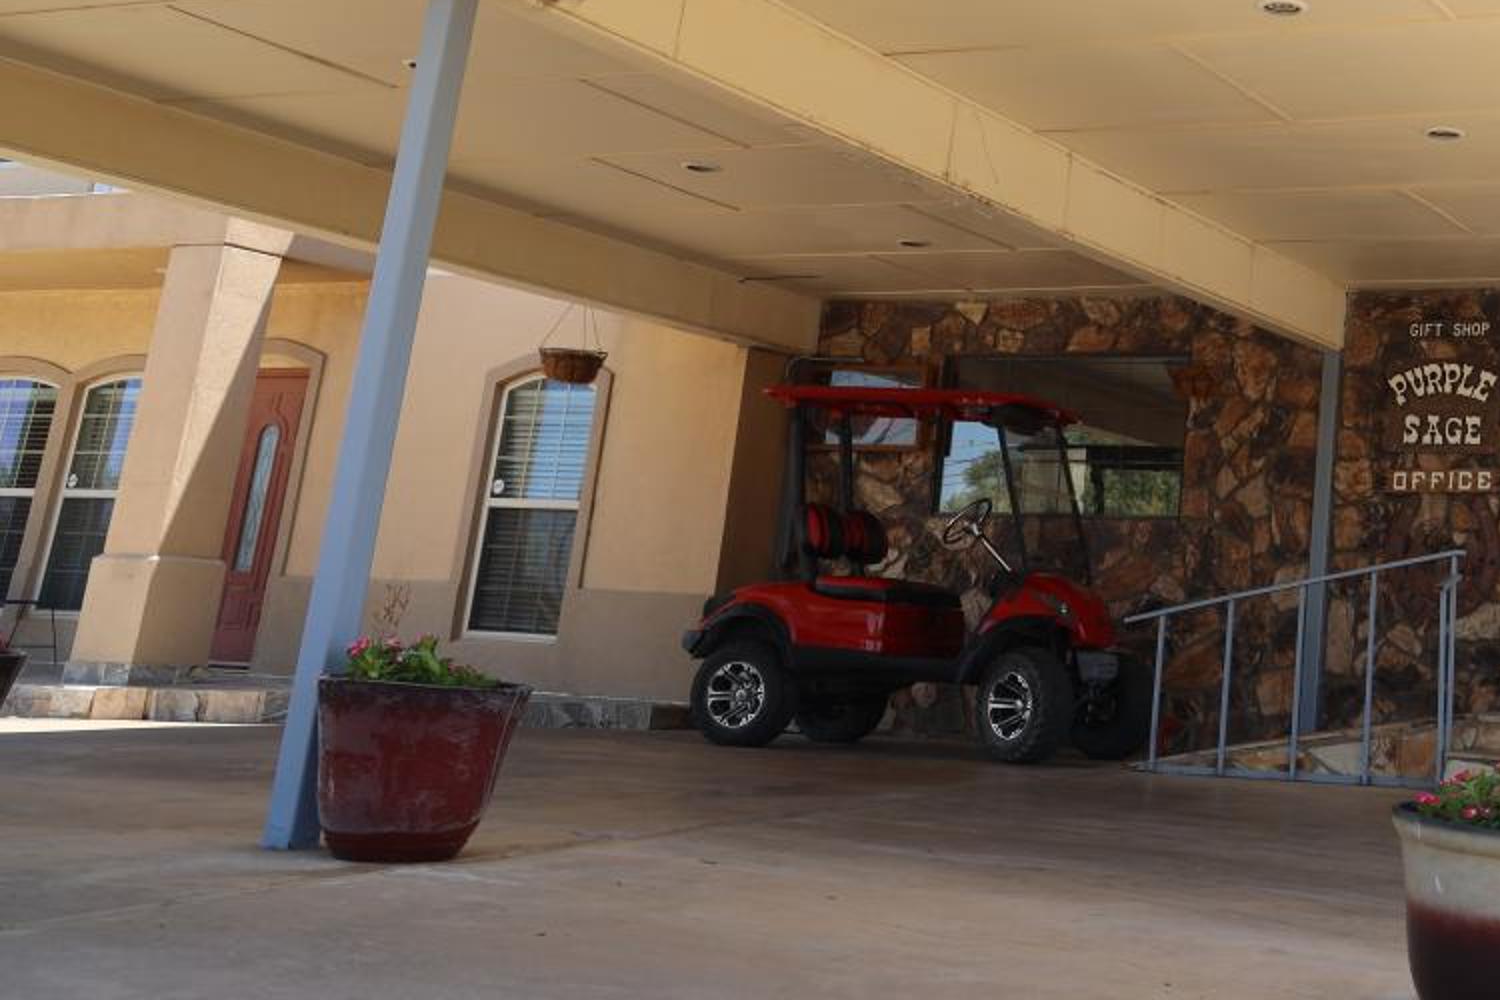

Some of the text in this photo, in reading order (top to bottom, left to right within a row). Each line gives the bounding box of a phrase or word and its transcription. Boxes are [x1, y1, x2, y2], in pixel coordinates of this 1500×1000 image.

[1409, 322, 1490, 337] GIFT SHOP
[1388, 362, 1498, 406] PURPLE
[1403, 414, 1481, 444] SAGE
[1393, 471, 1491, 490] OFFICE
